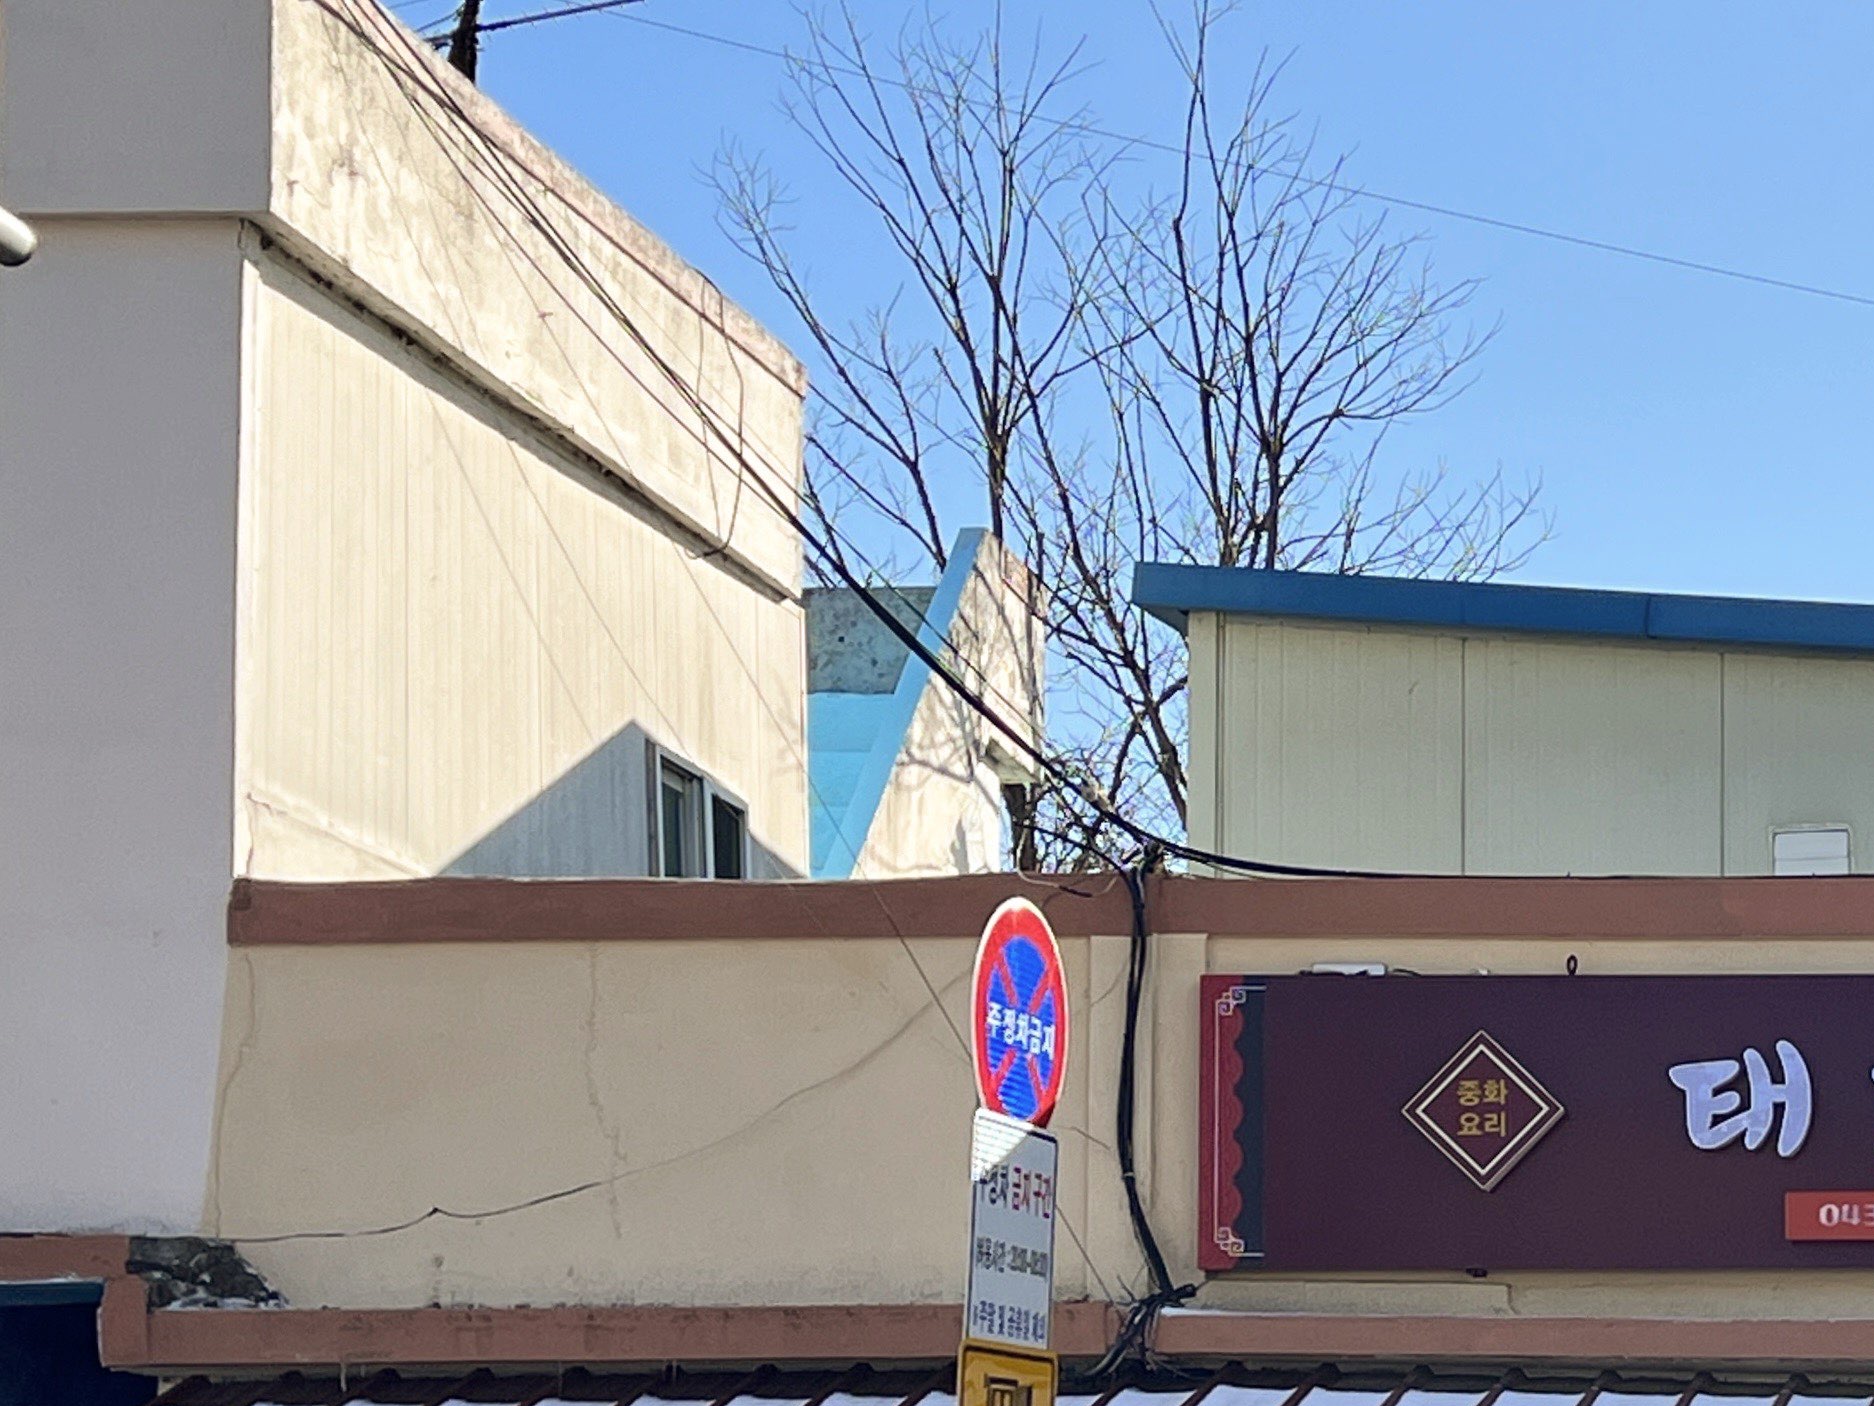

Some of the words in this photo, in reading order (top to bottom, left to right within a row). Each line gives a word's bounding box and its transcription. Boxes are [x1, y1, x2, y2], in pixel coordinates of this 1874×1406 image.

[987, 1001, 1055, 1060] 주정차금지
[1456, 1079, 1508, 1107] 중화
[1456, 1111, 1507, 1138] 요리
